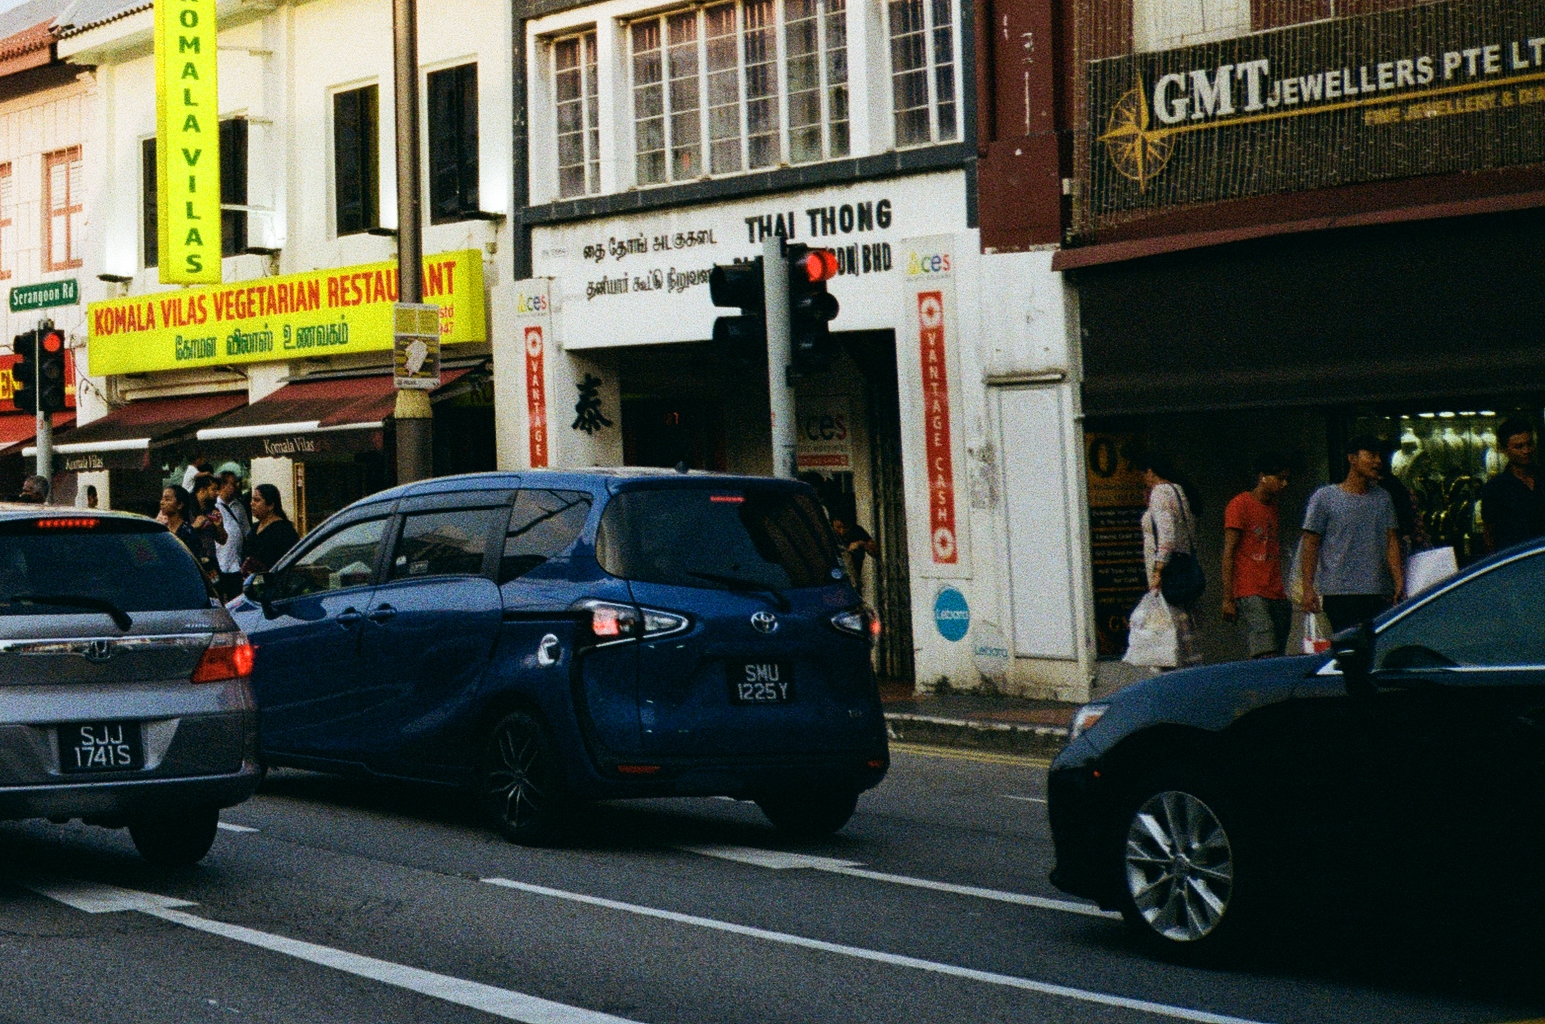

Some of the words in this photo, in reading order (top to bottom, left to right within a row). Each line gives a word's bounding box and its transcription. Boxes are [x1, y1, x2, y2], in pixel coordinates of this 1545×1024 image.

[1153, 59, 1270, 124] GMT
[1266, 55, 1434, 108] JEWELLERS
[1442, 44, 1500, 79] PTE
[1512, 37, 1545, 69] LT
[181, 148, 203, 274] VILAS
[745, 211, 795, 243] THAI
[806, 198, 892, 237] THONG
[13, 288, 60, 306] Serangoon
[62, 282, 74, 299] Rd
[94, 301, 156, 337] KOMALA
[160, 294, 207, 328] VILAS
[212, 279, 320, 322] VEGETARIAN
[327, 261, 456, 309] RESTAUNT
[531, 361, 542, 456] VANTAGE
[927, 332, 943, 447] VANTAGE
[264, 438, 295, 455] Komala
[295, 437, 315, 452] Vilas
[935, 457, 948, 522] CASH
[745, 663, 779, 682] SMU
[74, 744, 131, 768] 1741S
[80, 725, 124, 746] SJJ
